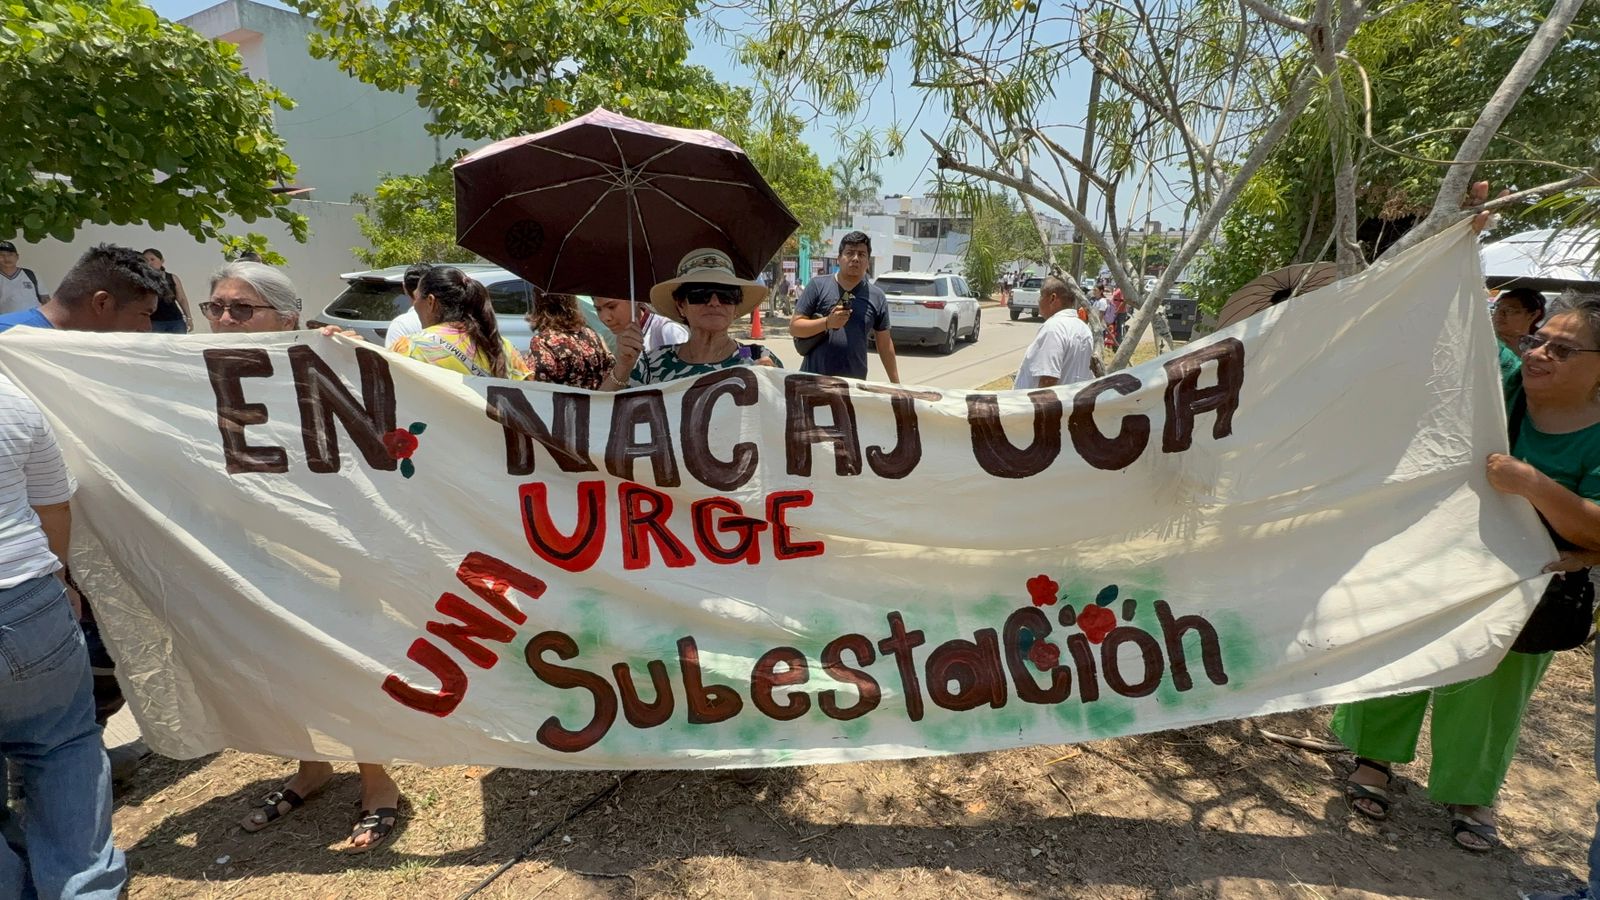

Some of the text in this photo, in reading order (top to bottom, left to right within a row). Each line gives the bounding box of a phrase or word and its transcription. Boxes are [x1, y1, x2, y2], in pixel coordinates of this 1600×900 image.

[203, 344, 398, 474] EN
[518, 480, 825, 573] URGE
[381, 551, 548, 718] UNA
